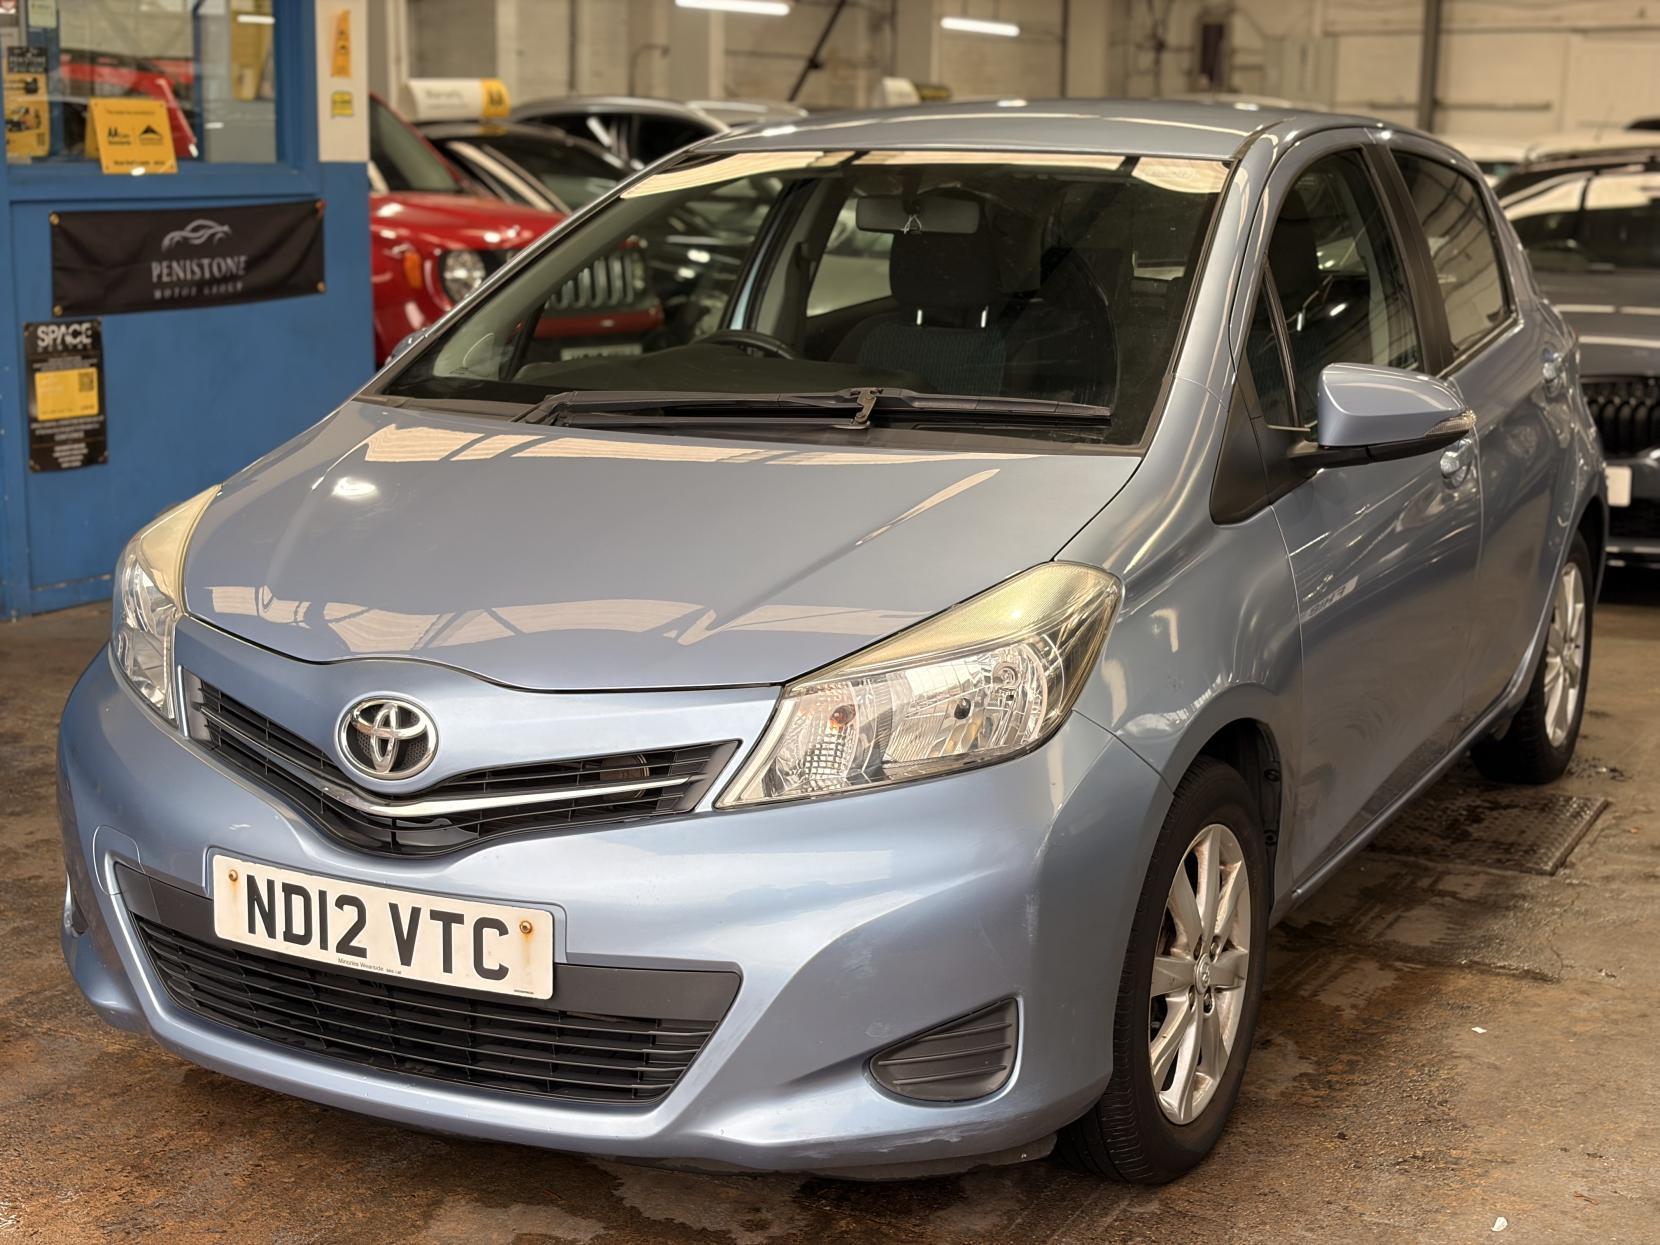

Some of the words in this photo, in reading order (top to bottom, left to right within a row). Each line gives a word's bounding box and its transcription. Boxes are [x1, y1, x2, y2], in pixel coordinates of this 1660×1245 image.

[151, 255, 247, 283] PENISTONE
[36, 323, 92, 347] SPACE
[246, 873, 368, 959] ND12
[388, 902, 510, 981] VTC
